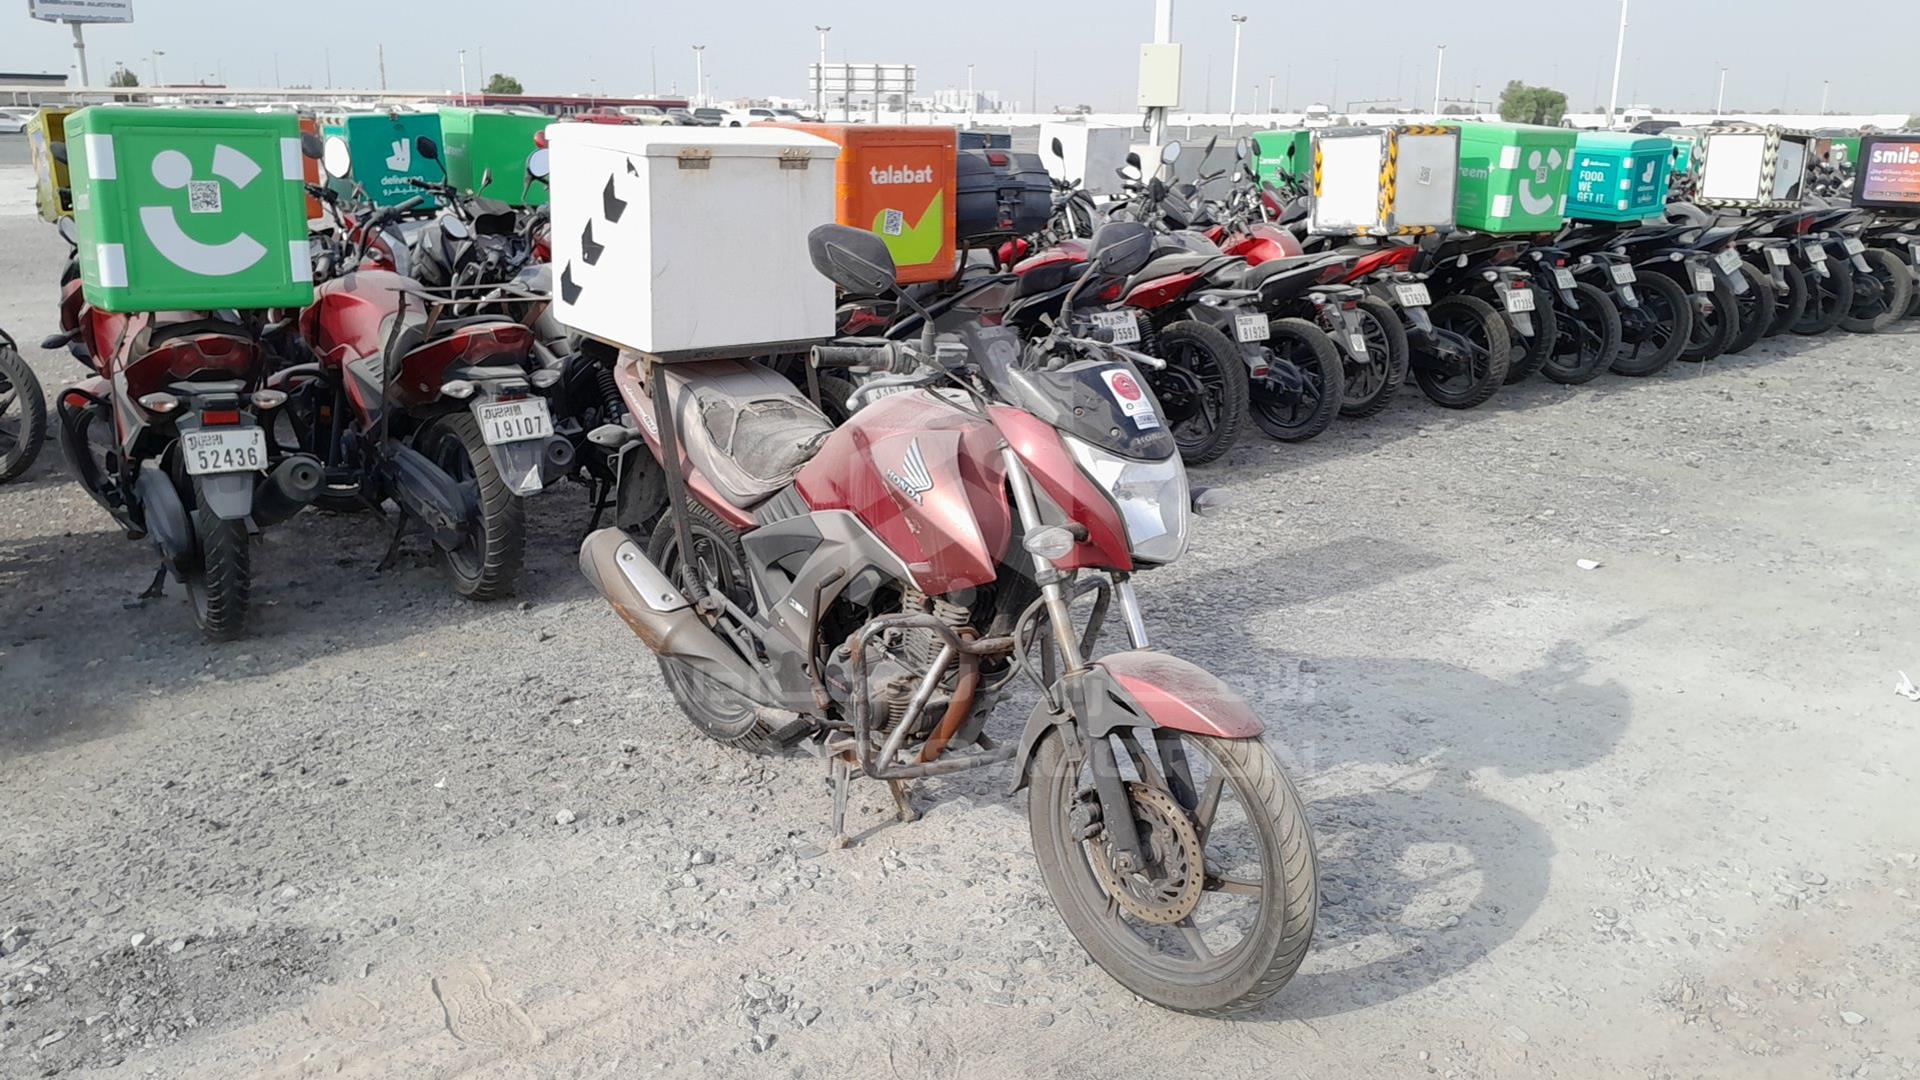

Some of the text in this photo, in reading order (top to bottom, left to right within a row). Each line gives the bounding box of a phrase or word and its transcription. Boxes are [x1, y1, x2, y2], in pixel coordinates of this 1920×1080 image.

[1872, 146, 1920, 164] smile
[869, 164, 933, 185] talabat
[1577, 192, 1594, 202] GET
[1578, 181, 1592, 192] WE
[495, 416, 542, 439] 19107
[198, 448, 258, 470] 52436
[885, 468, 924, 506] HONDA
